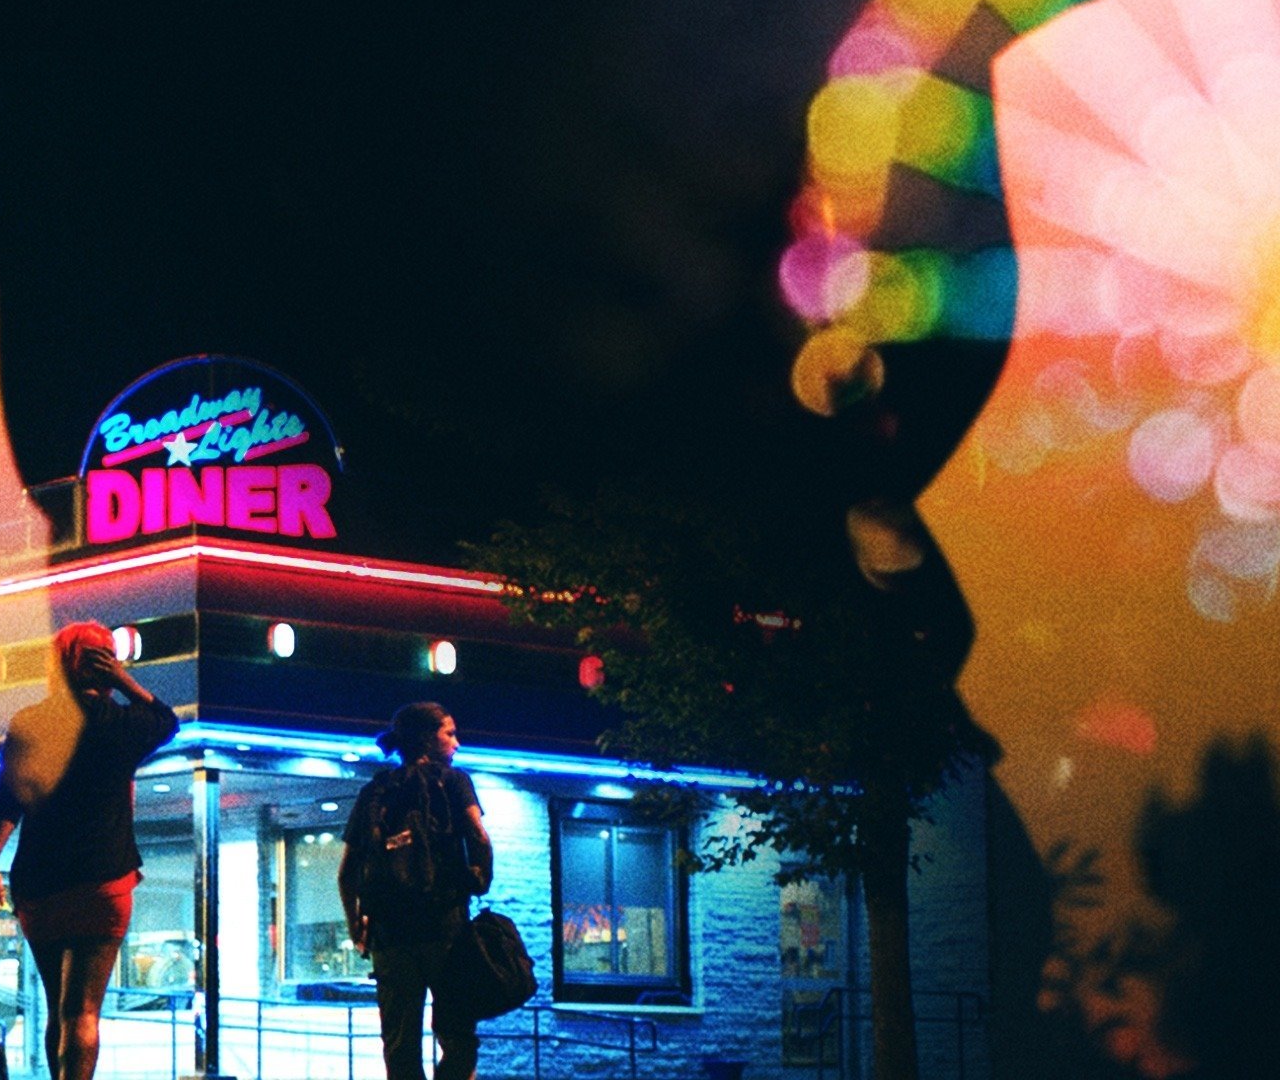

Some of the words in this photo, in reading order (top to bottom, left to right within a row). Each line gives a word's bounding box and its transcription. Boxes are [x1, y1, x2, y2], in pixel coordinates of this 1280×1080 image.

[100, 387, 262, 453] Broadway
[188, 409, 306, 463] Lights
[86, 463, 338, 545] DINER
